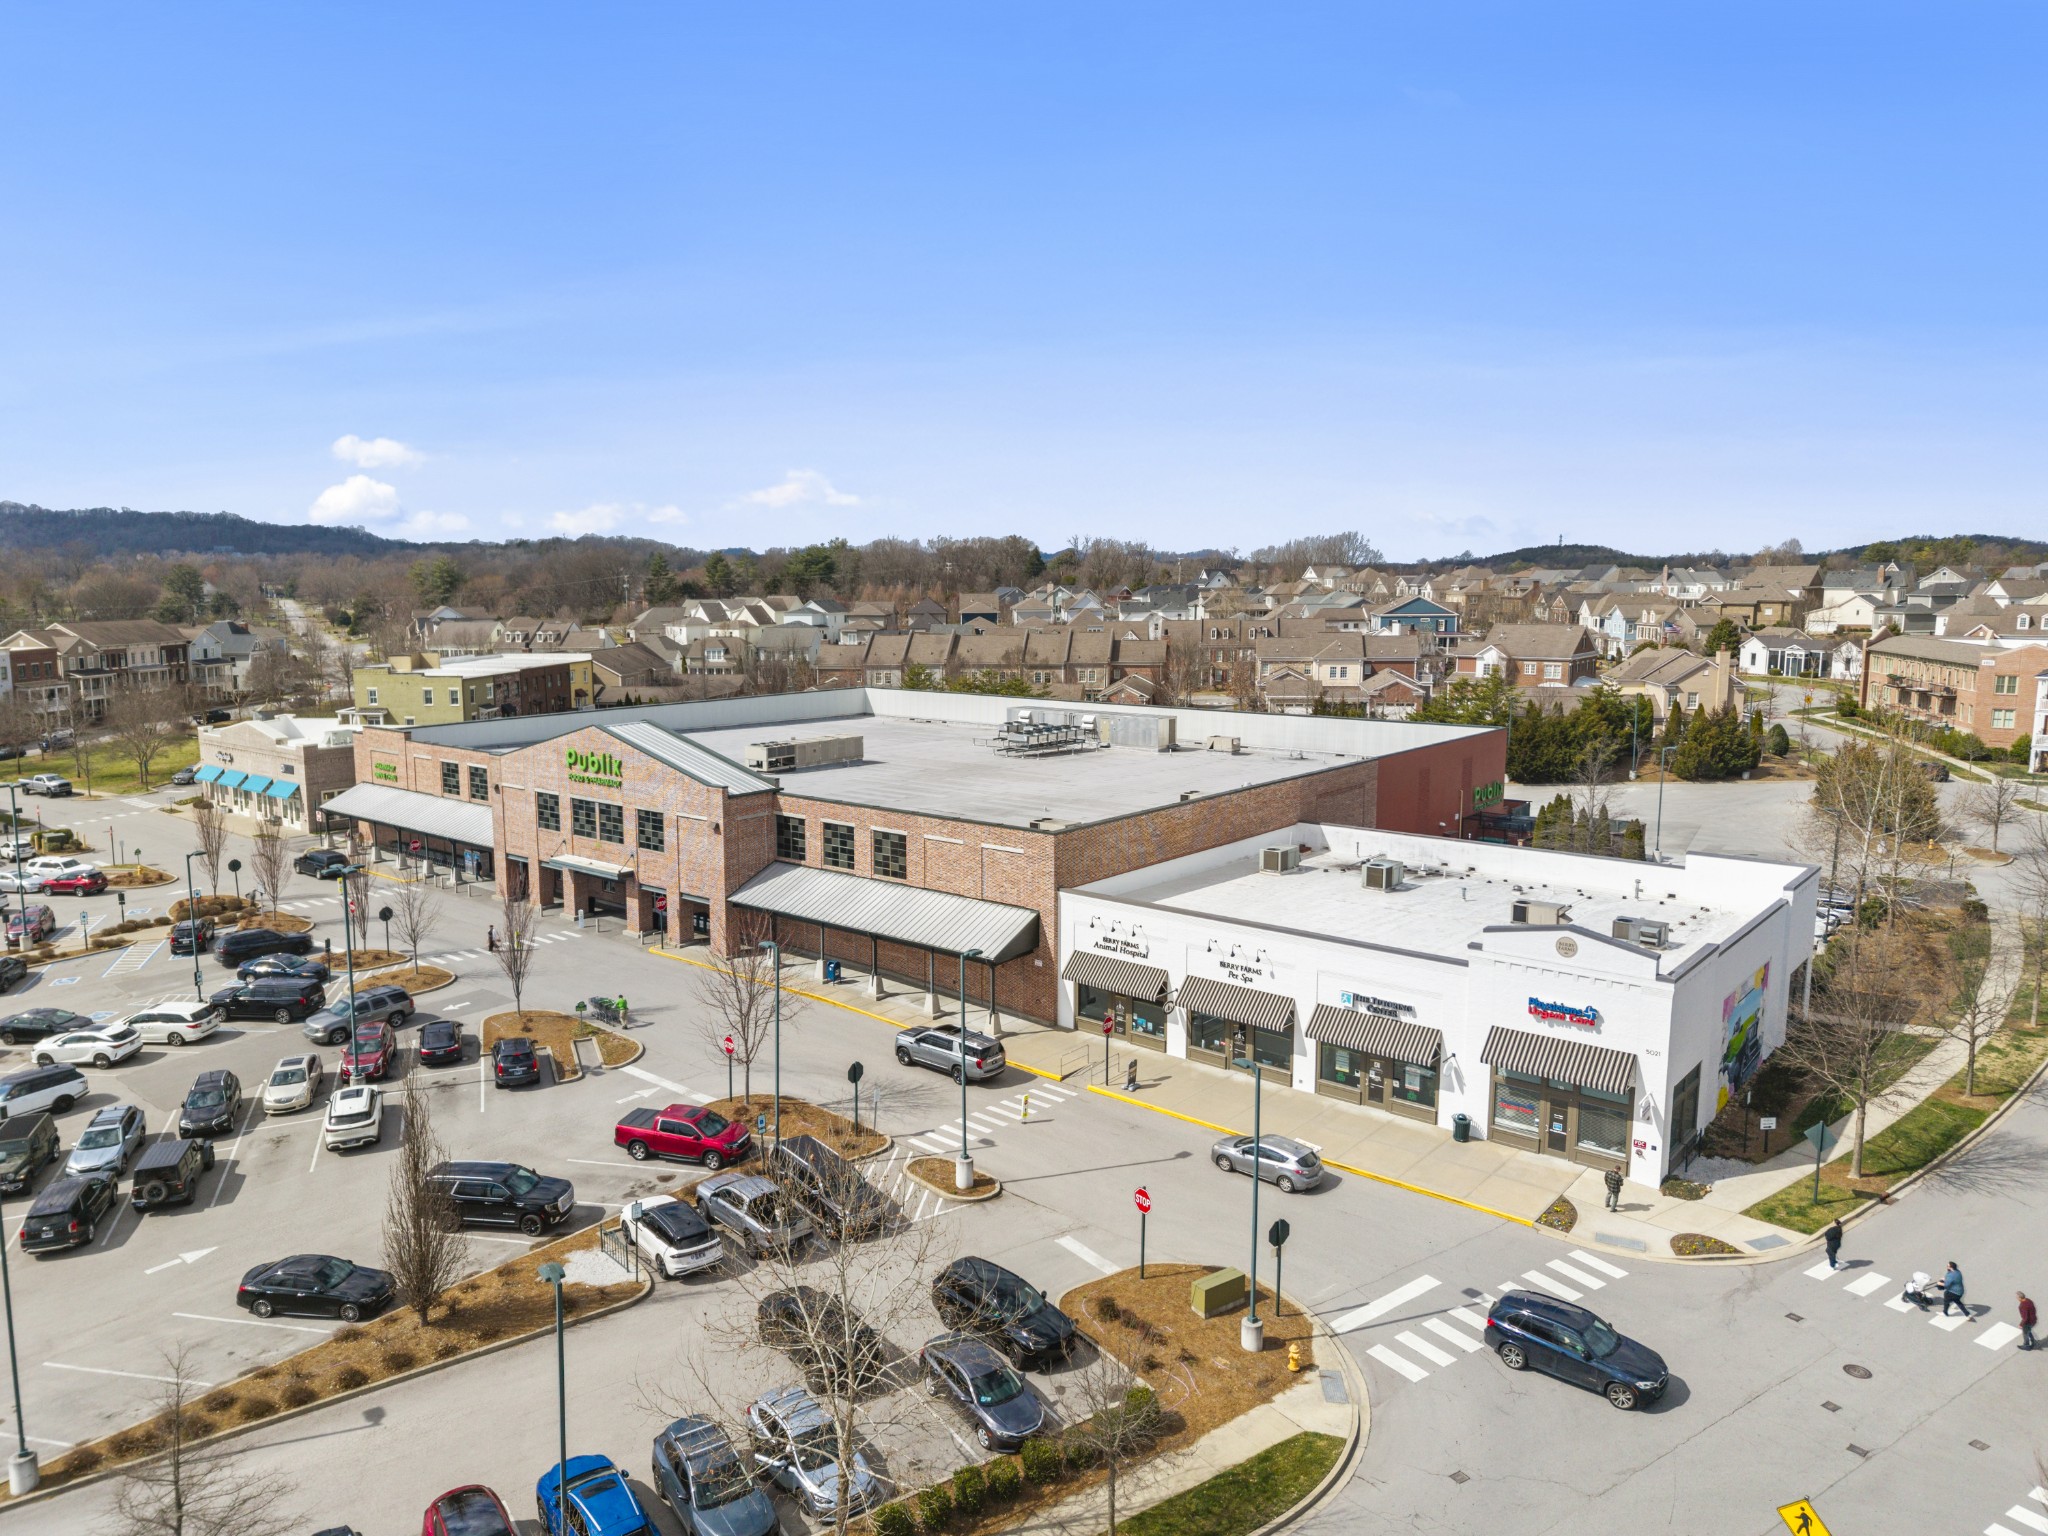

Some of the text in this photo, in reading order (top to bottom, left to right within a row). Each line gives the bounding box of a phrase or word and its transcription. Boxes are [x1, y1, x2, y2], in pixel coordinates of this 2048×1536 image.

[566, 747, 623, 778] Publix
[1093, 941, 1149, 959] Animal Hospital
[1219, 961, 1262, 976] BERRY FARMS
[1240, 973, 1253, 984] Spa
[1528, 997, 1583, 1016] Physicians
[1528, 1006, 1595, 1026] Urgent Care
[1135, 1193, 1150, 1207] STOP
